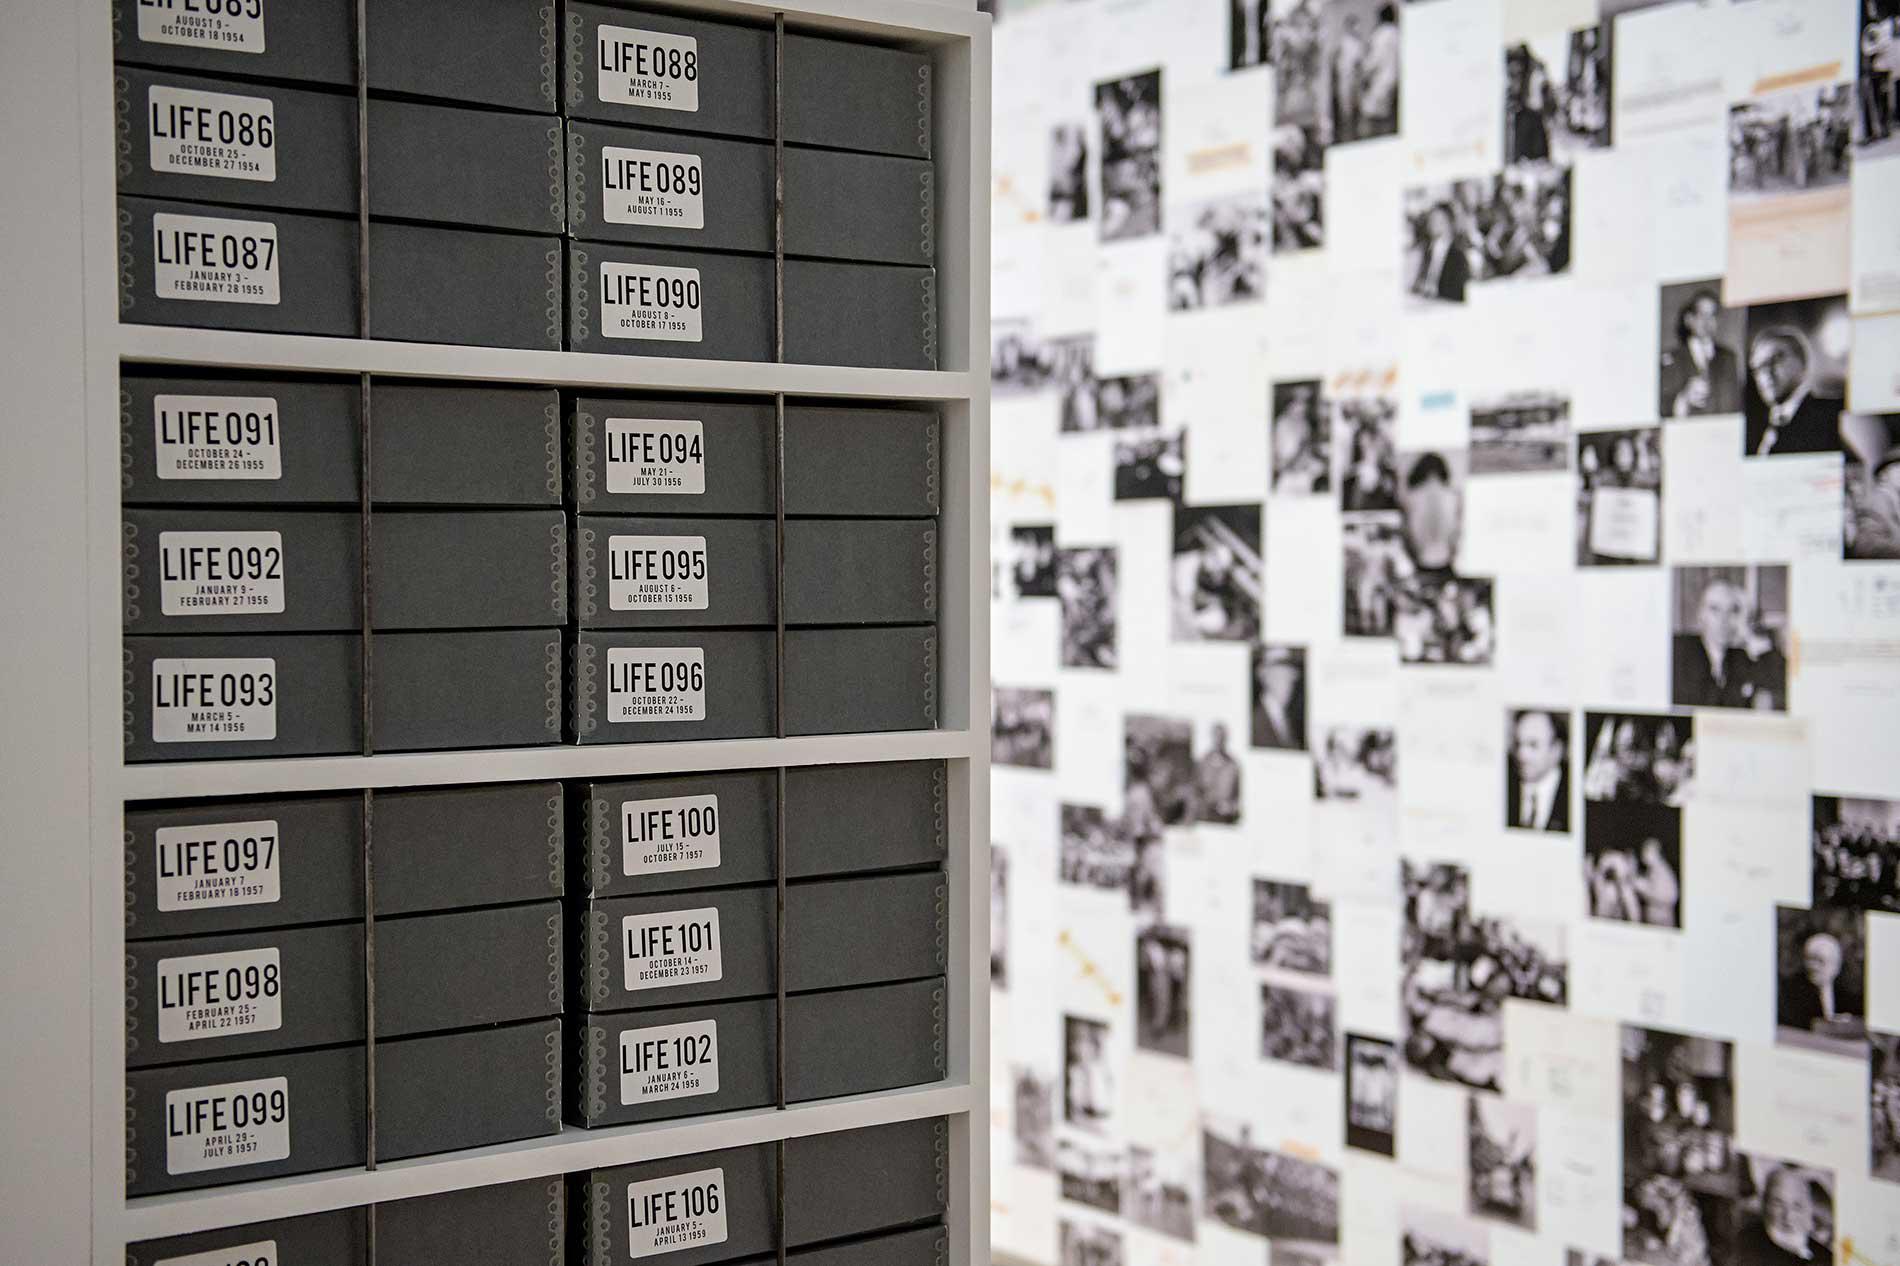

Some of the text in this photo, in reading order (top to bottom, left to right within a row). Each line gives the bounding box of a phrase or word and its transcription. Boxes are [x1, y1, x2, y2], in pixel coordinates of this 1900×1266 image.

[175, 15, 213, 28] AUGUST
[161, 24, 244, 43] OCTOBER 18 1954
[630, 78, 657, 89] MARCH
[629, 88, 644, 98] MAY
[654, 91, 671, 101] 1955
[180, 144, 224, 158] OCTOBER
[227, 149, 238, 159] 25
[169, 154, 259, 172] DECEMBER 27 1954
[638, 195, 654, 205] MAY
[657, 197, 664, 206] 16
[627, 205, 657, 215] AUGUST
[665, 208, 683, 217] 1955
[190, 270, 231, 282] JANUARY
[174, 280, 264, 295] FEBRUARY 28 1955
[632, 310, 661, 319] AUGUST
[620, 319, 686, 330] OCTOBER 17 1955
[188, 448, 230, 459] OCTOBER
[233, 449, 243, 458] 24
[176, 459, 264, 470] DECEMBER 26 1955
[641, 467, 656, 476] MAY
[659, 468, 667, 476] 21
[633, 477, 681, 486] JULY 30 1956
[196, 585, 237, 595] JANUARY
[639, 584, 668, 593] AUGUST
[180, 595, 268, 606] FEBRUARY 27 1956
[628, 594, 692, 603] OCTOBER 15 1956
[632, 696, 666, 705] OCTOBER
[669, 696, 677, 704] 22
[623, 705, 693, 715] DECEMBER 24 1956
[191, 712, 224, 721] MARCH
[187, 722, 244, 732] MAY 14 1956
[657, 843, 673, 853] JULY
[676, 842, 684, 851] 15
[643, 852, 677, 864] OCTOBER
[686, 850, 702, 859] 1957
[195, 877, 236, 889] JANUARY
[177, 885, 263, 901] FEBRUARY 18 1957
[649, 957, 682, 969] OCTOBER
[684, 956, 692, 965] 14
[640, 964, 708, 980] DECEMBER 23 1957
[186, 1006, 235, 1020] FEBRUARY
[238, 1004, 249, 1014] 25
[189, 1014, 255, 1031] APRIL 22 1957
[648, 1072, 681, 1084] JANUARY
[642, 1079, 699, 1094] MARCH 24 1958
[205, 1135, 232, 1147] APRIL
[236, 1132, 247, 1143] 29
[203, 1146, 224, 1159] JULY
[236, 1142, 257, 1154] 1957
[656, 1222, 690, 1236] JANUARY
[654, 1229, 706, 1247] APRIL 13 1959
